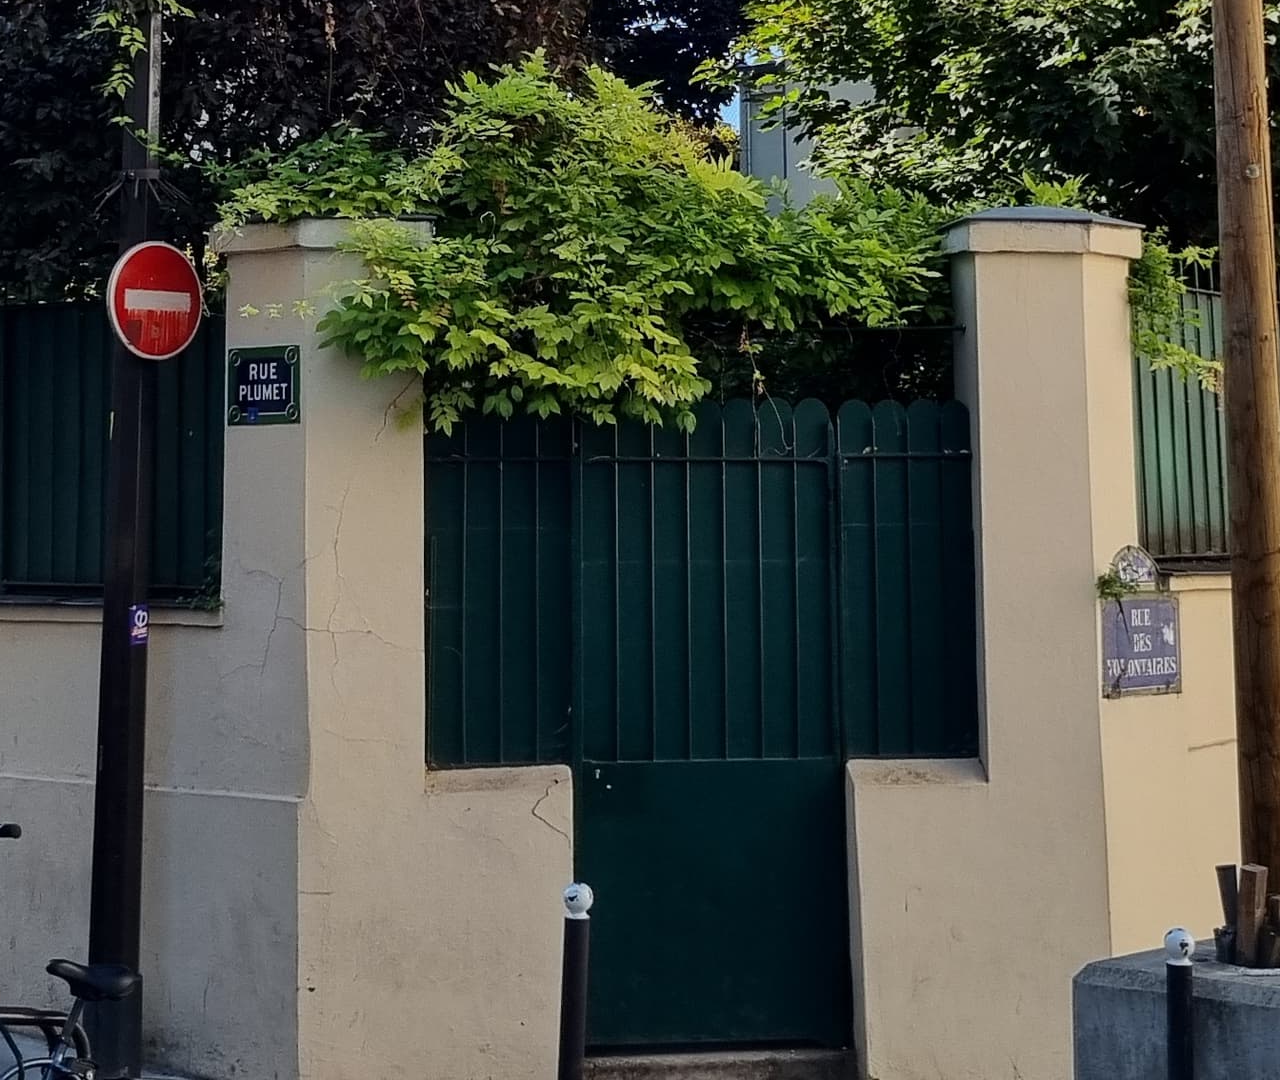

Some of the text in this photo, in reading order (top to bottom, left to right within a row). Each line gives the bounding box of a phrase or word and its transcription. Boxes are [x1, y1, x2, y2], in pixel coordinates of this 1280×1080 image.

[249, 363, 277, 380] RUE
[239, 383, 288, 401] PLUMET
[1131, 609, 1151, 626] RUE
[1133, 633, 1152, 652] DES
[1107, 656, 1177, 678] VOLONTAIRES
